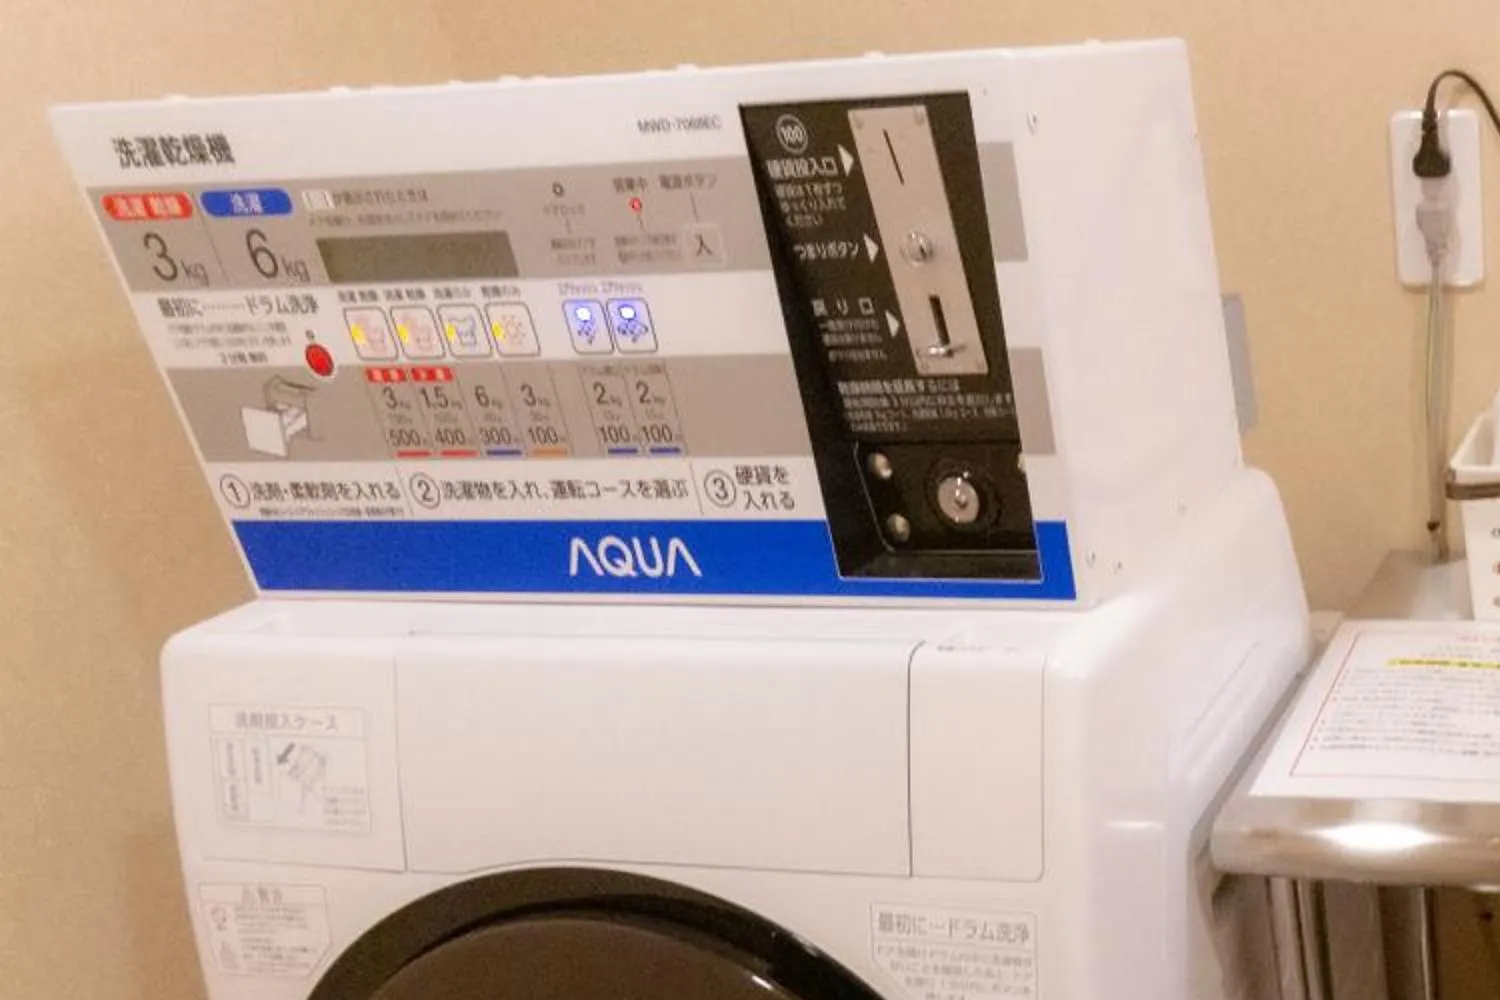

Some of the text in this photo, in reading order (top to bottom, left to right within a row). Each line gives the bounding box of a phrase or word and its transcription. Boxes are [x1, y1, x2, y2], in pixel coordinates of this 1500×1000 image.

[111, 132, 235, 169] 洗濯乾燥機
[568, 535, 703, 578] AQUA
